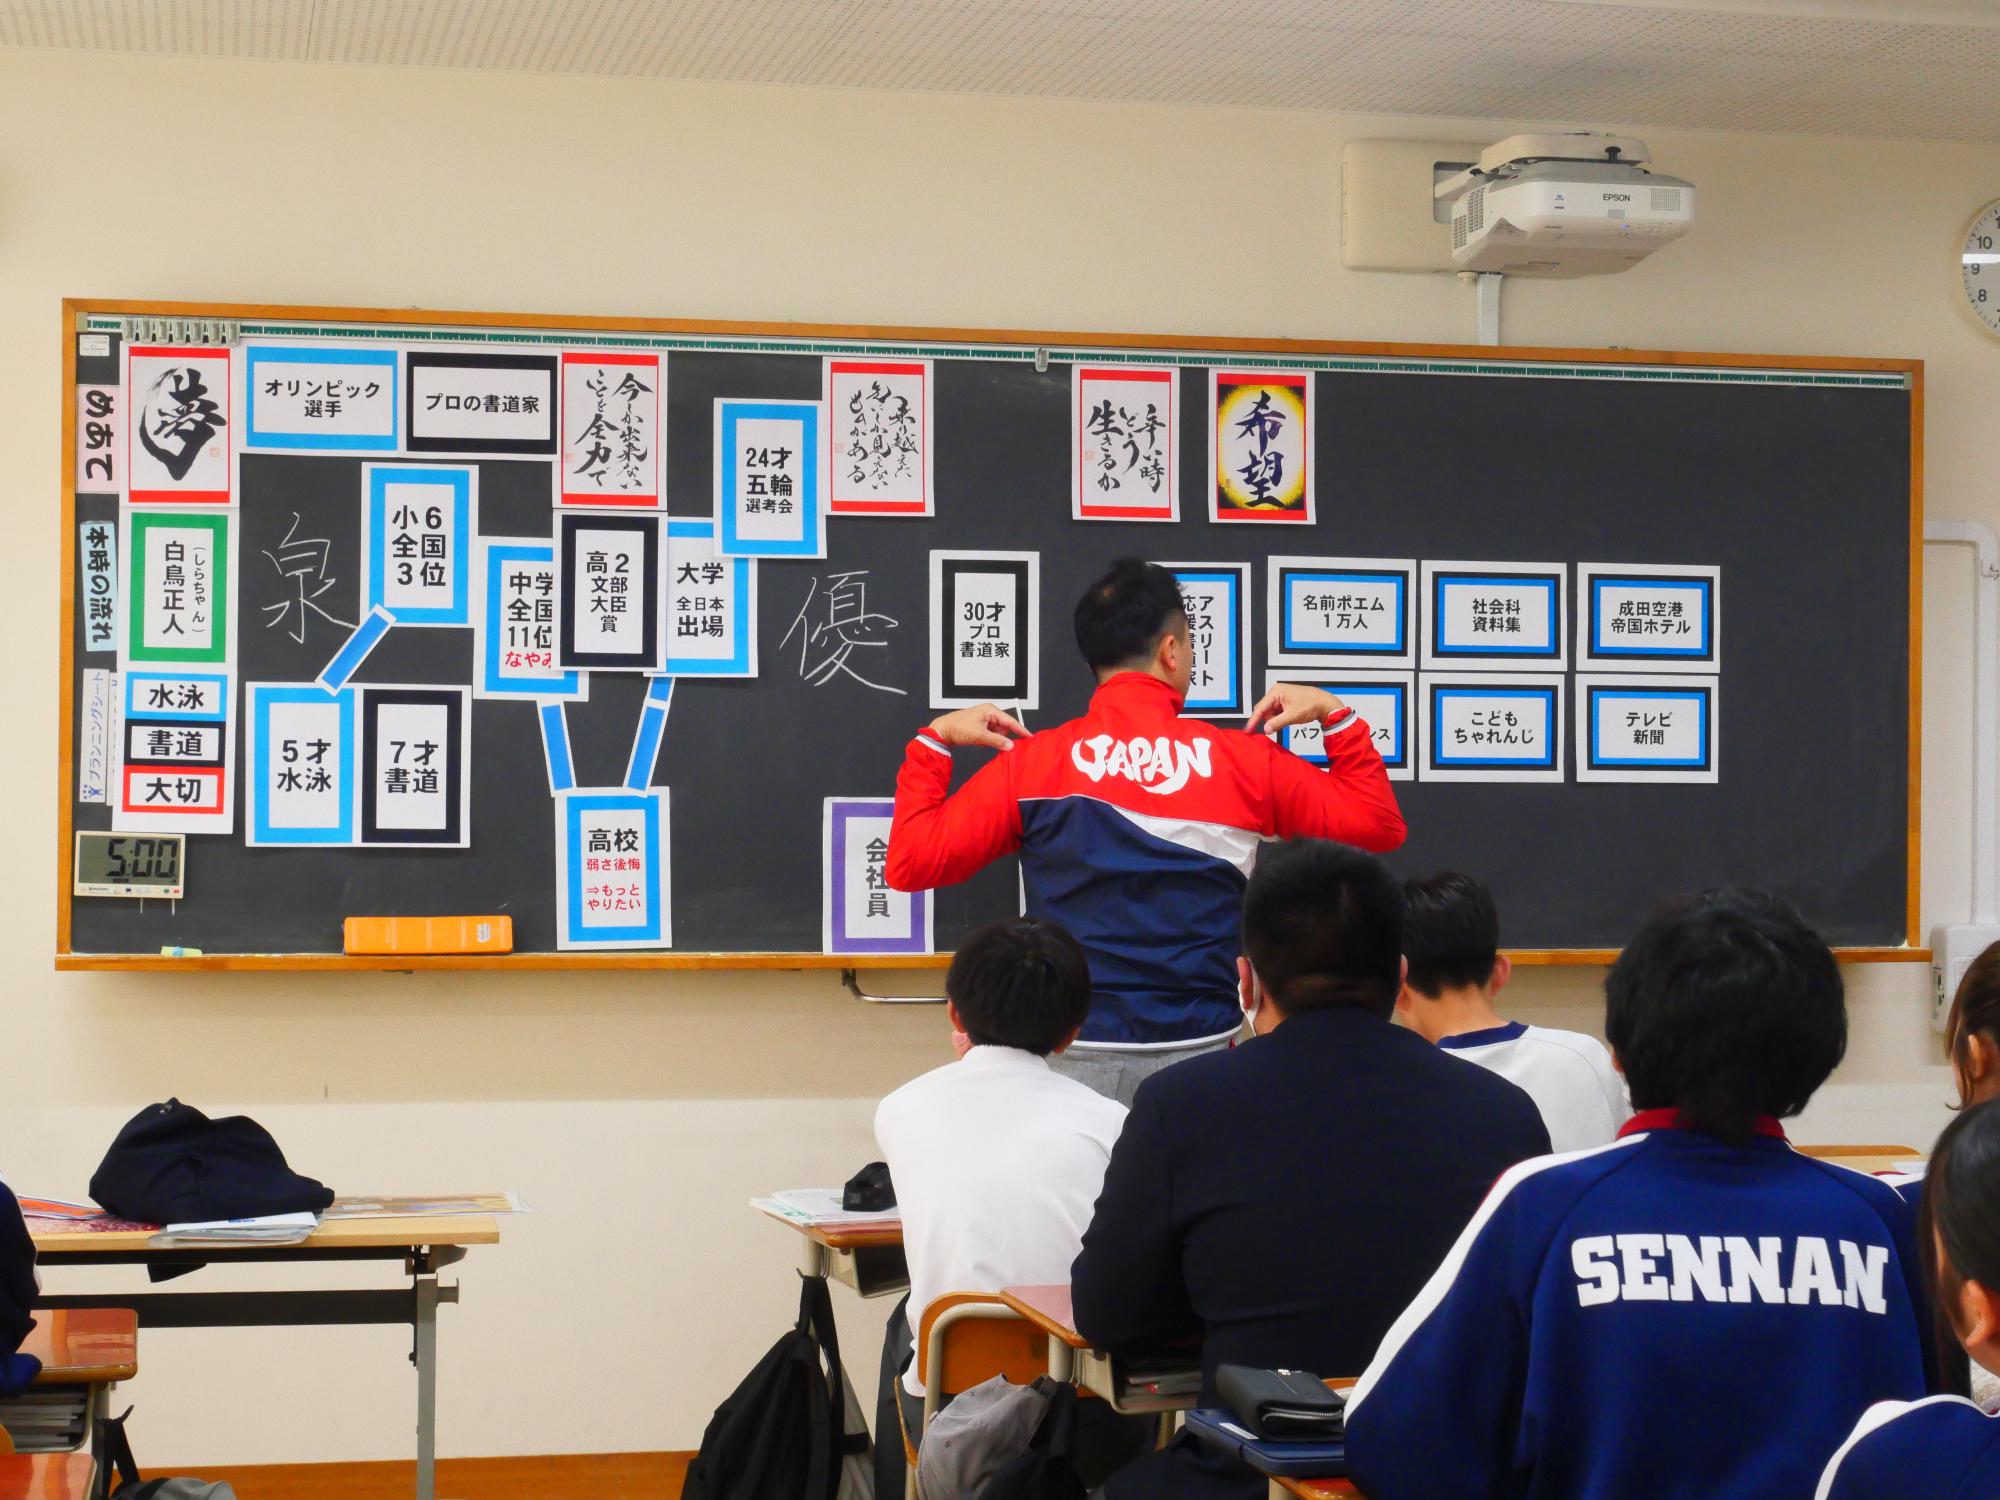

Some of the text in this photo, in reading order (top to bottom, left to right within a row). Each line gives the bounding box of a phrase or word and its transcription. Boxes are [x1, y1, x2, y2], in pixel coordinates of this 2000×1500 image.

[1603, 193, 1631, 202] EPSON
[1976, 236, 1993, 249] 10
[1971, 263, 1980, 275] 9
[1978, 289, 1987, 302] 8
[265, 380, 380, 399] オリンピック
[304, 399, 342, 418] 選手
[426, 393, 540, 414] プロの書道家
[85, 389, 114, 481] めあて
[573, 369, 620, 487] ことを全力で
[611, 373, 654, 489] 今しか出来ない
[1086, 399, 1125, 492] 生きるか
[1234, 390, 1287, 507] 希望
[745, 447, 793, 470] 24才
[746, 474, 793, 497] 五輪
[391, 505, 443, 530] 小6
[745, 498, 793, 514] 選考会
[391, 532, 446, 560] 全国
[397, 561, 446, 587] 3位
[586, 551, 630, 574] 高2
[676, 562, 724, 585] 大学
[86, 526, 114, 643] 本時の流れ
[162, 540, 185, 635] 白鳥正人
[261, 511, 360, 644] 泉
[591, 576, 628, 594] 文部
[507, 597, 552, 623] 全国
[590, 595, 627, 613] 大臣
[677, 595, 725, 612] 全日本
[963, 602, 1006, 622] 30才
[1303, 595, 1385, 612] 名前ポエム
[1472, 598, 1521, 615] 社会科
[1618, 601, 1684, 618] 成田空港
[600, 615, 617, 633] 賞
[677, 614, 724, 638] 出場
[779, 571, 908, 695] 優
[969, 624, 1000, 640] プロ
[1323, 613, 1368, 630] 1万人
[1472, 616, 1521, 633] 資料集
[1611, 618, 1692, 635] 帝国ホテル
[959, 641, 1009, 659] 書道家
[1198, 596, 1214, 687] アスリート
[148, 683, 204, 710] 水泳
[1471, 711, 1518, 727] こども
[1625, 712, 1672, 728] テレビ
[147, 730, 203, 757] 書道
[1454, 727, 1534, 745] ちゃれんじ
[1633, 728, 1664, 745] 新聞
[282, 739, 332, 765] 5才
[390, 739, 439, 766] 7才
[1071, 734, 1212, 795] JAPAN
[145, 777, 201, 804] 大切
[277, 766, 332, 793] 水泳
[384, 767, 439, 794] 書道
[588, 828, 639, 853] 高校
[106, 839, 178, 878] 5:00
[587, 858, 641, 872] 弱さ後悔
[866, 837, 890, 918] 会社員
[588, 898, 641, 911] やりたい
[1571, 1233, 1889, 1315] SENNAN
